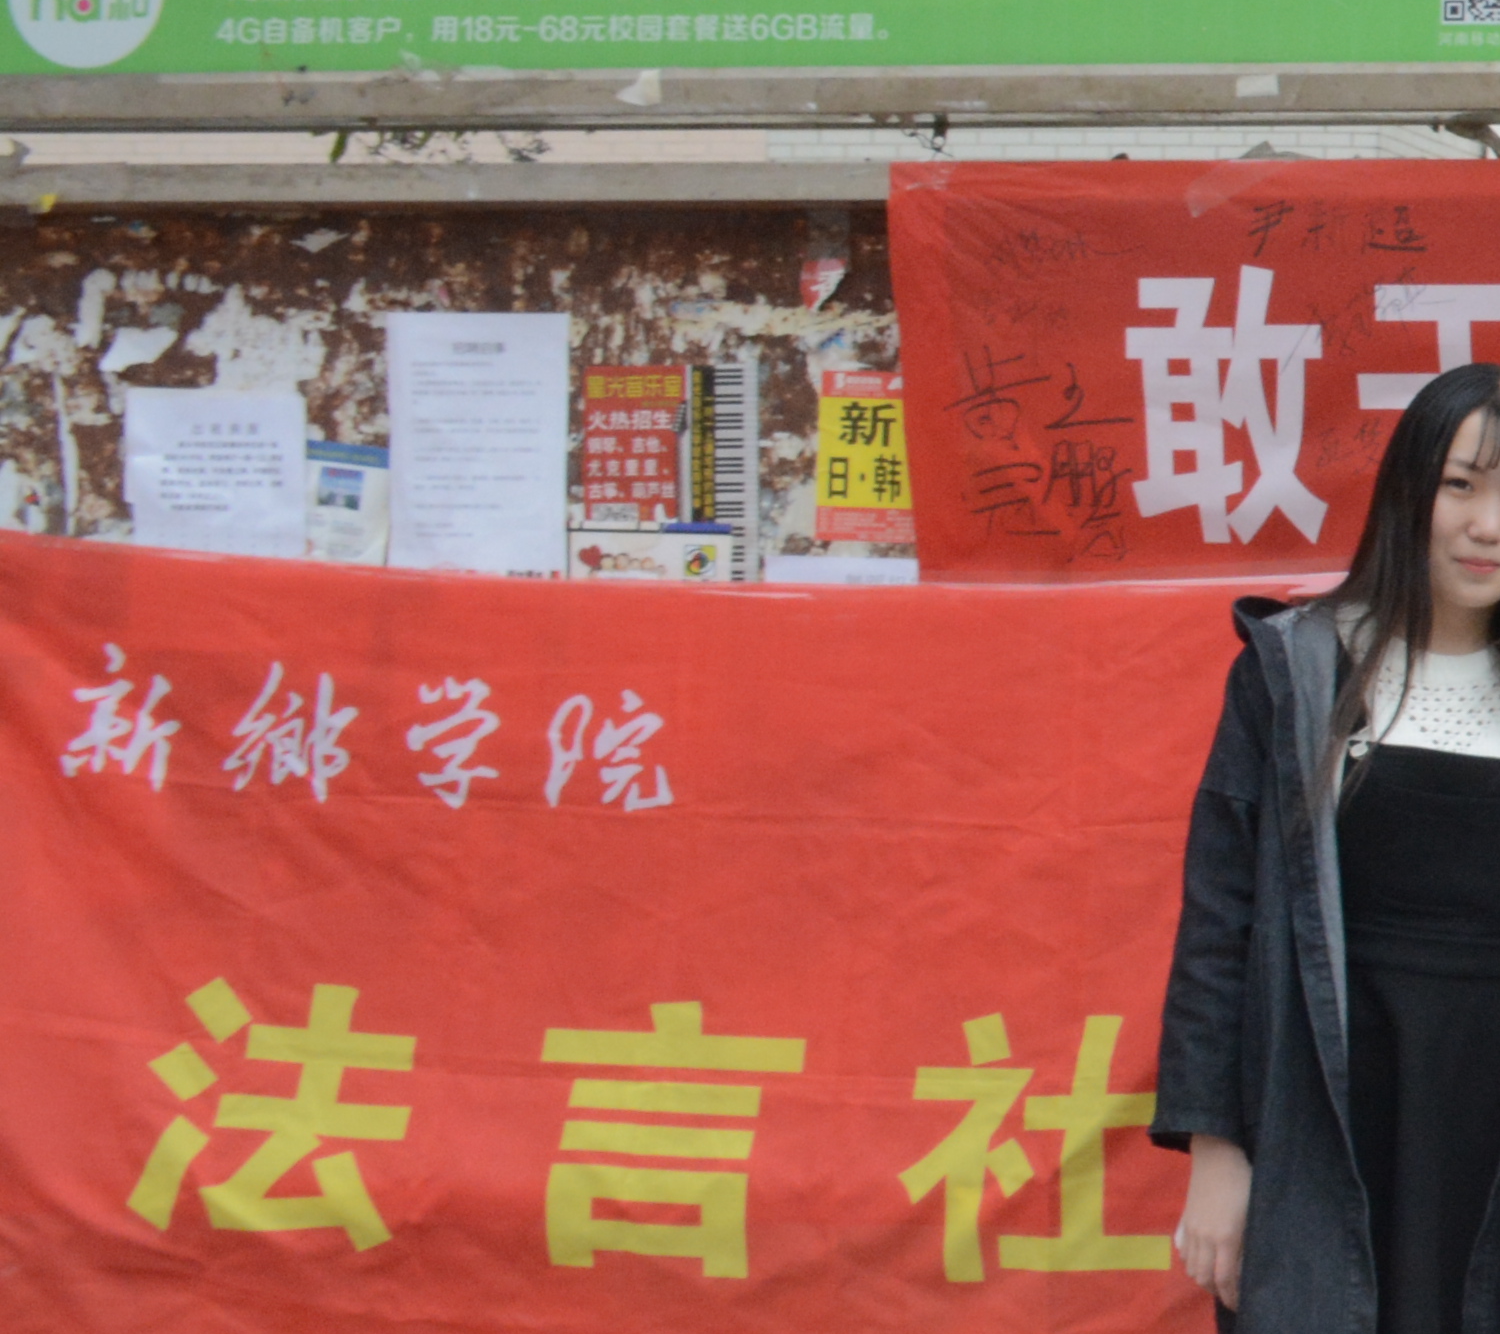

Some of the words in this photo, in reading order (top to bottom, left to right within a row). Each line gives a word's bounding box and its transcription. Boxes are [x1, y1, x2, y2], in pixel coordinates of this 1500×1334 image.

[588, 409, 673, 432] 火热招生
[839, 400, 897, 448] 新
[126, 975, 1174, 1283] 法言社
